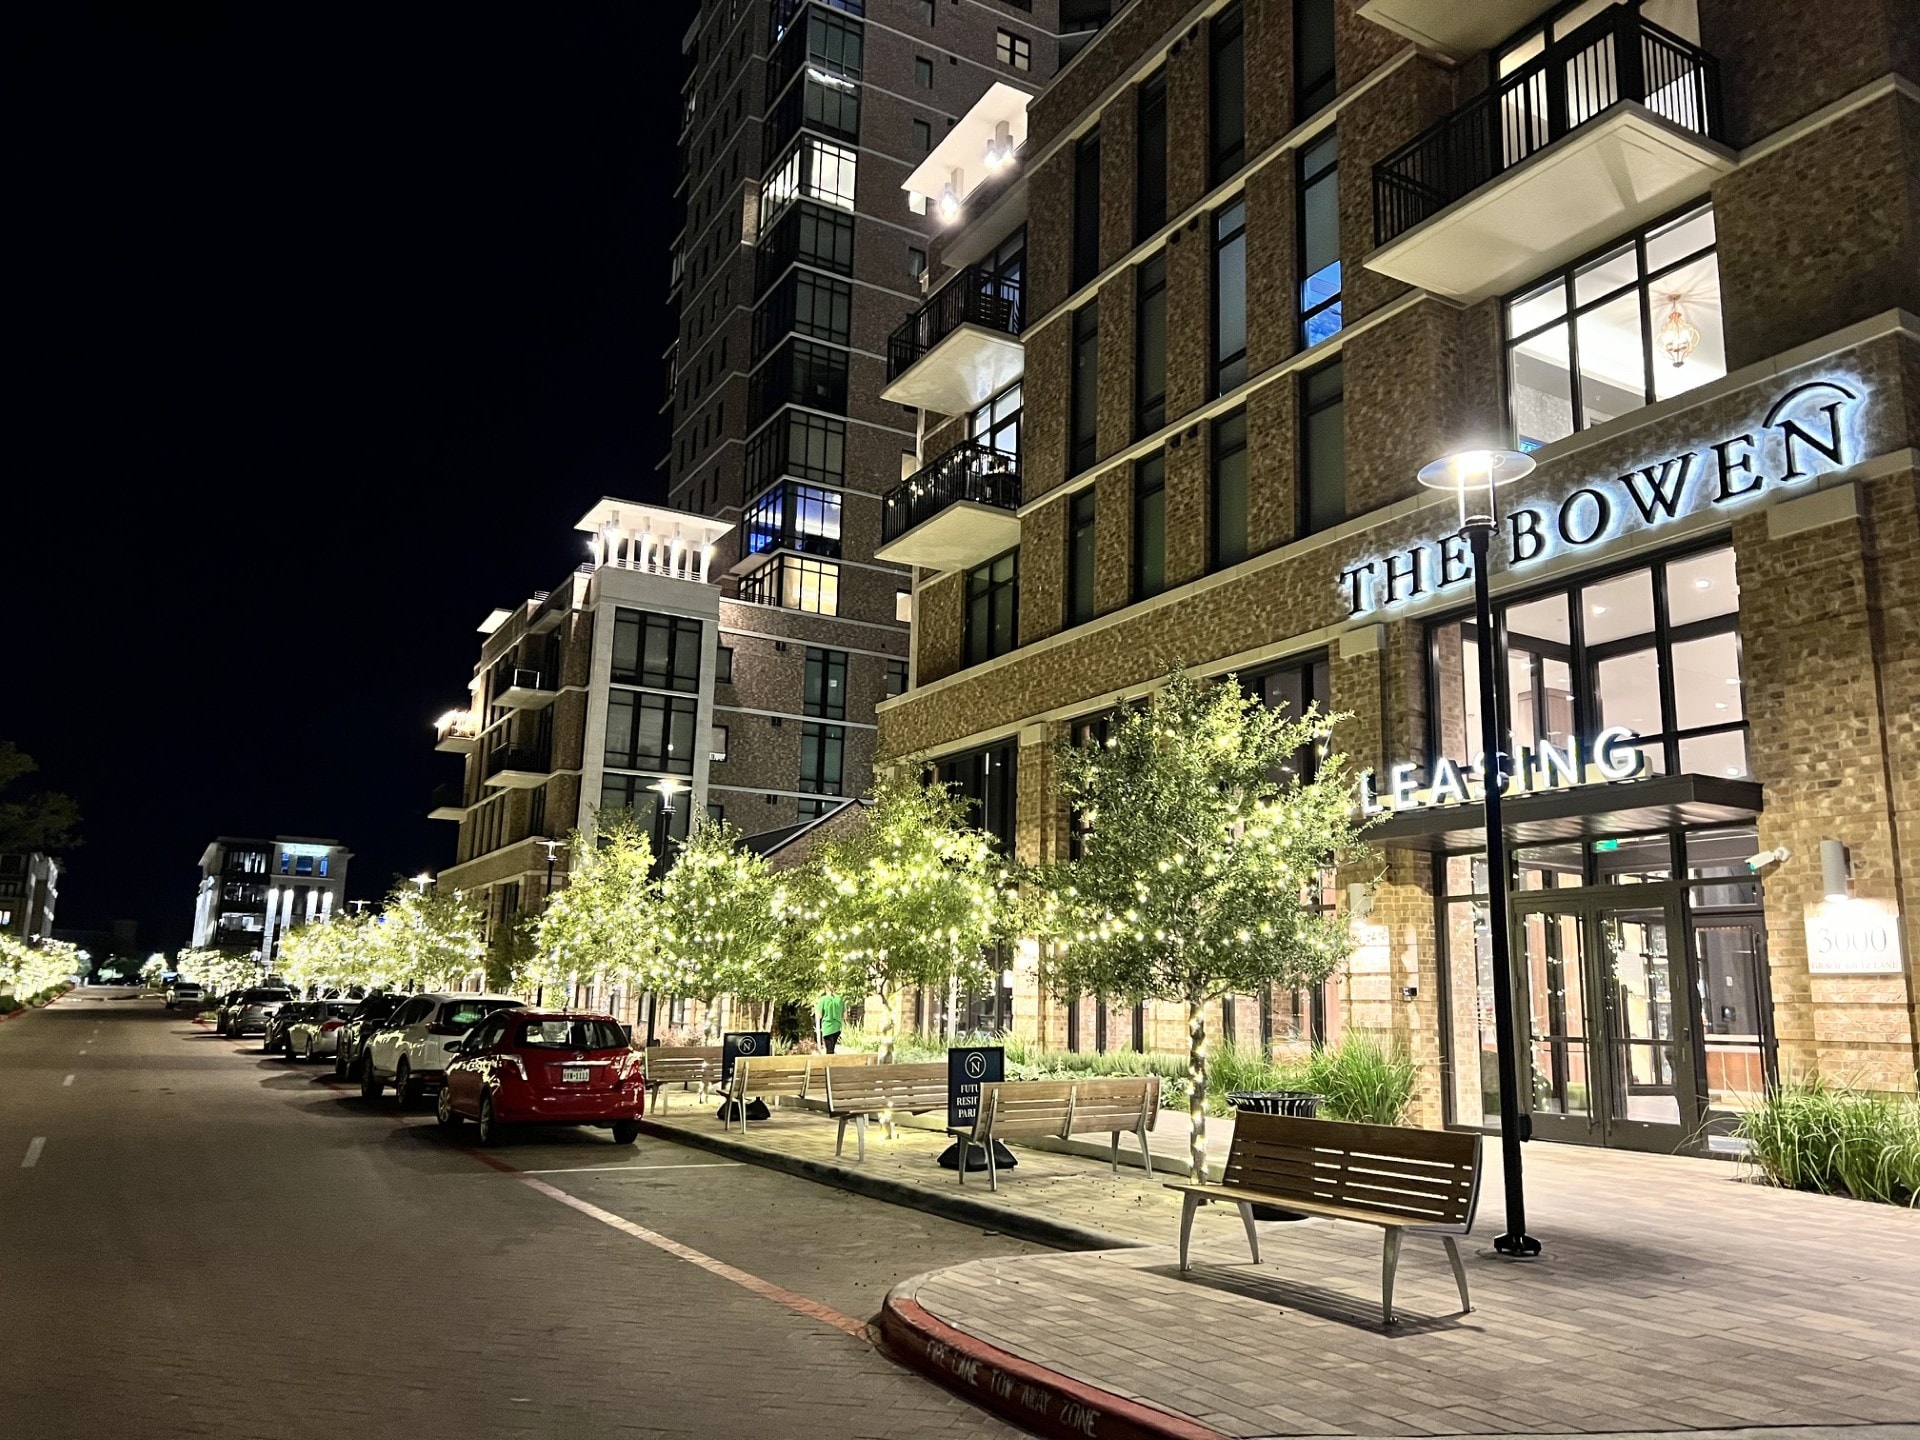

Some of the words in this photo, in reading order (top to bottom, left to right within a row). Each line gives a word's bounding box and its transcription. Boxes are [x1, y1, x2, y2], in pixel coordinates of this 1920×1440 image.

[1339, 533, 1472, 615] THE
[1508, 382, 1856, 566] BOWEN
[1817, 926, 1887, 953] 3000
[991, 1369, 1015, 1398] TOW
[1060, 1401, 1101, 1438] ZONE
